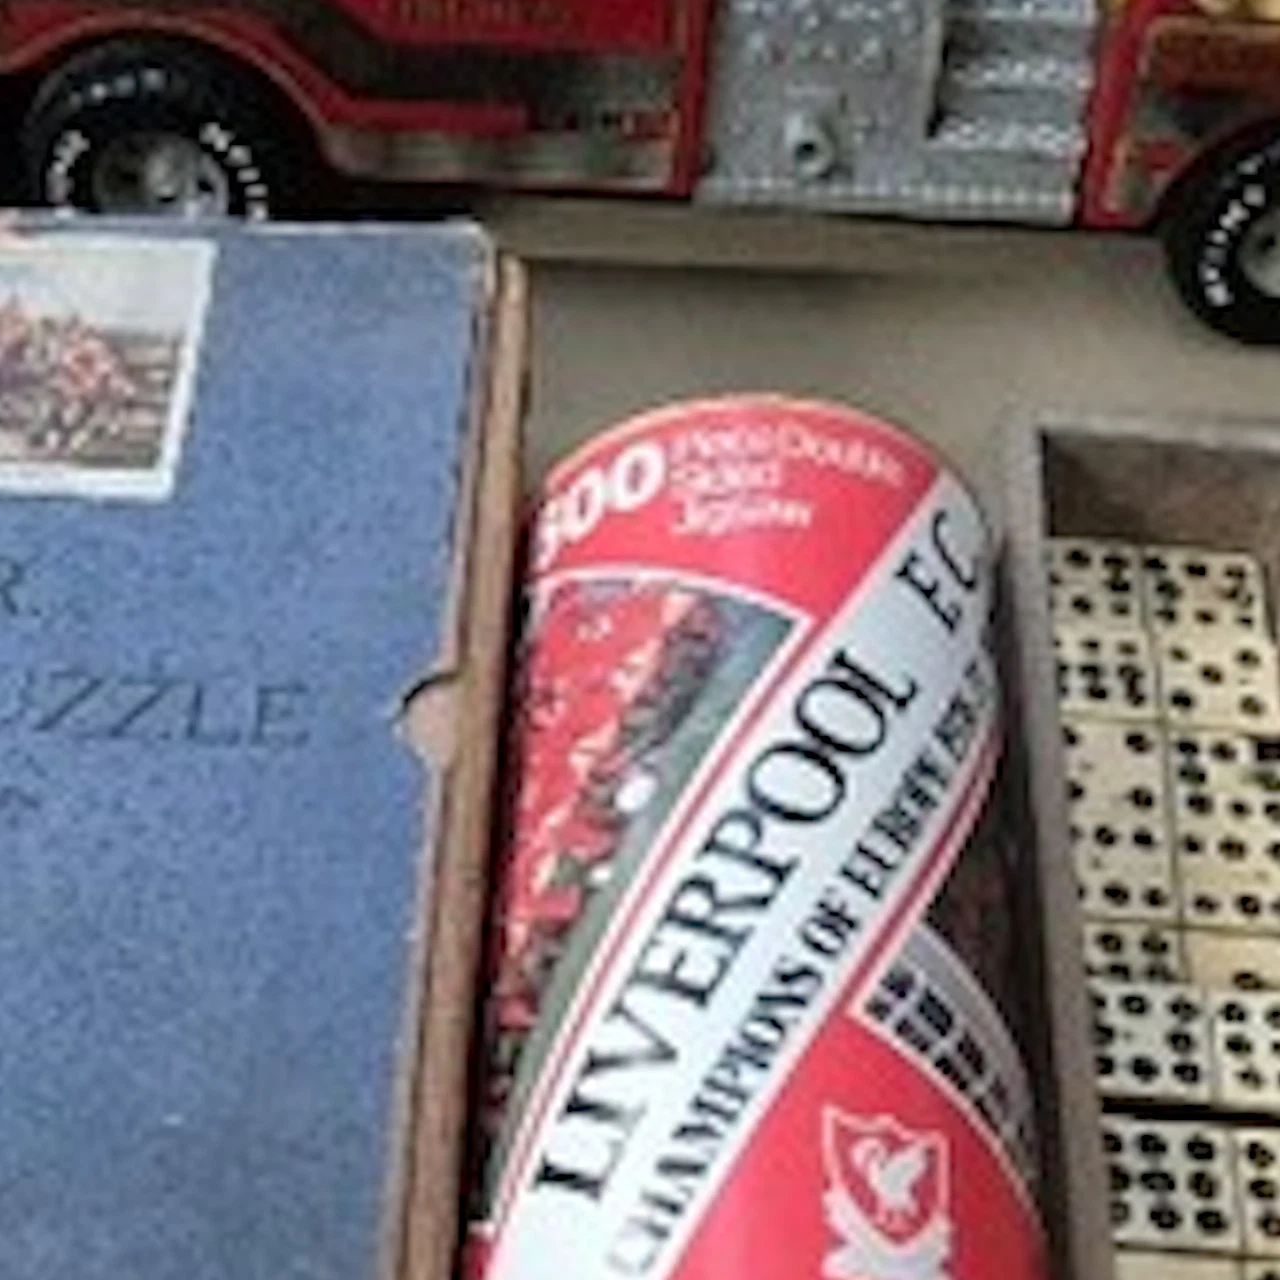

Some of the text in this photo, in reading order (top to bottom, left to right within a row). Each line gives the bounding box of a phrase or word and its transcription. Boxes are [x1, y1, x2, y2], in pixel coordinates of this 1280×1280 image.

[534, 648, 918, 1205] LIVERPOOL
[606, 955, 822, 1275] CHAMPIONS
[801, 888, 859, 958] OF
